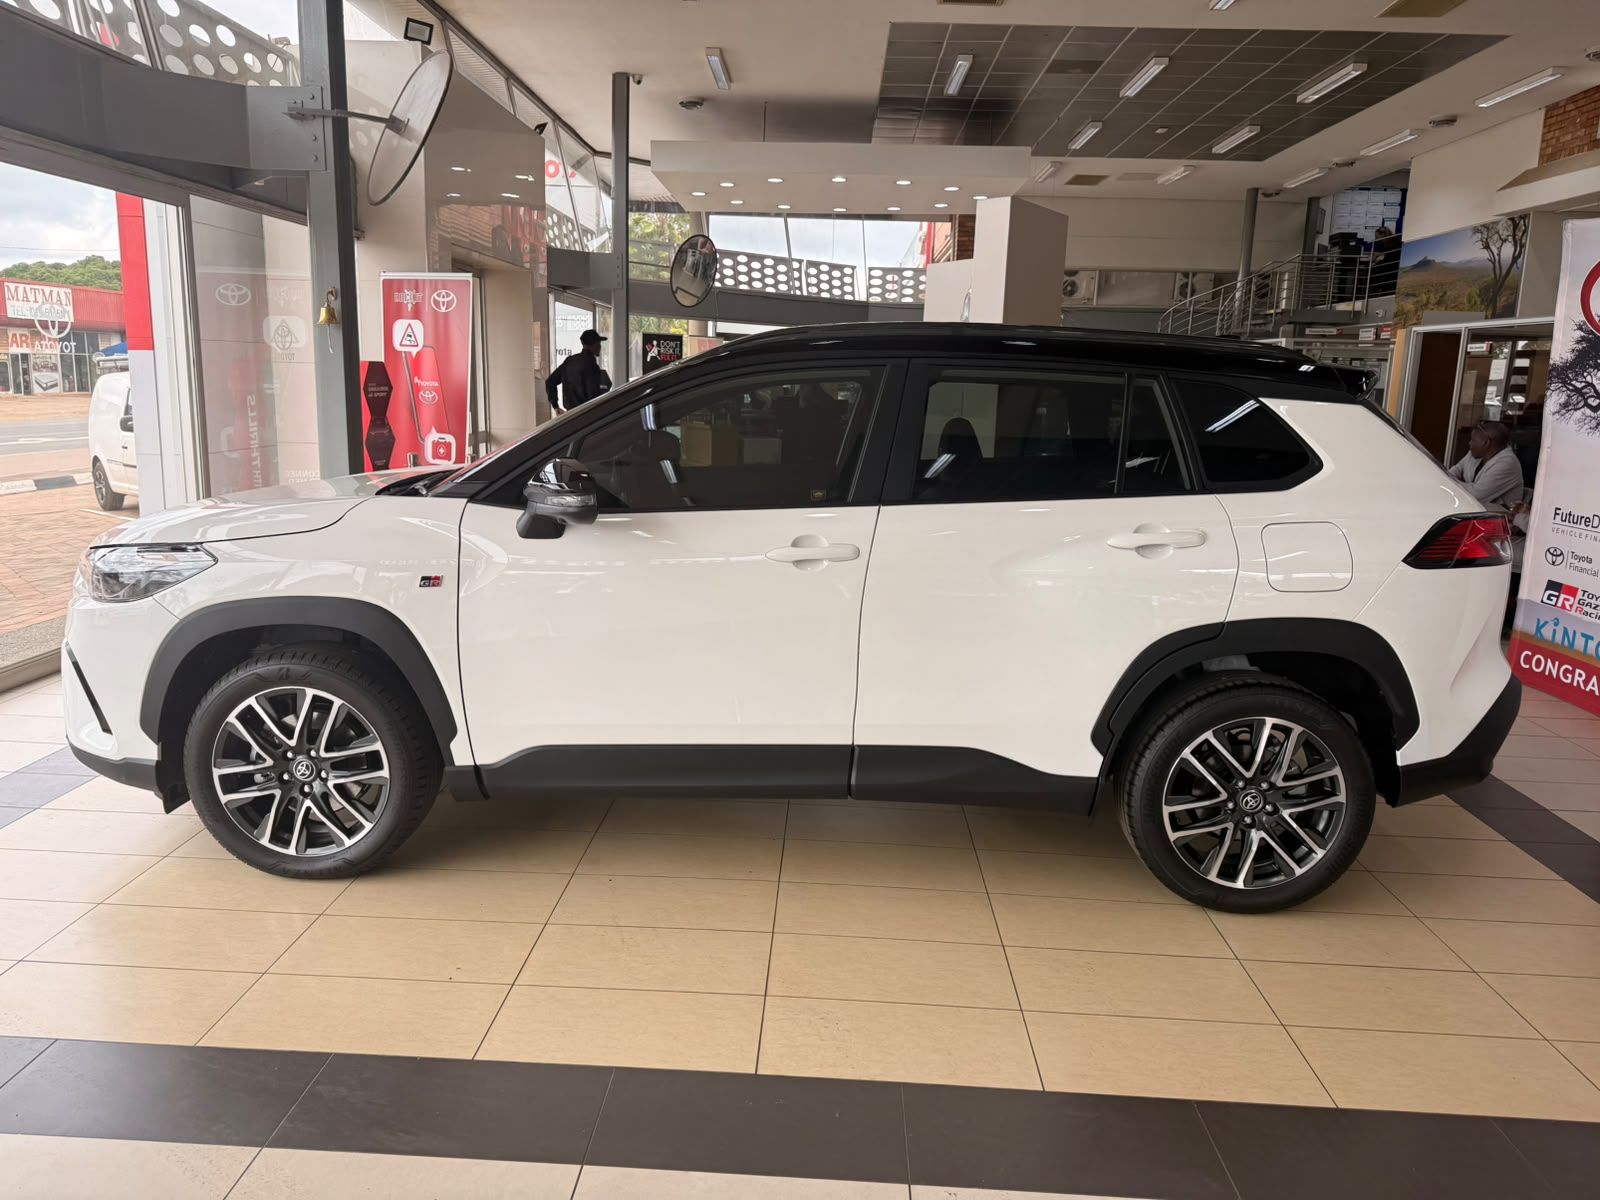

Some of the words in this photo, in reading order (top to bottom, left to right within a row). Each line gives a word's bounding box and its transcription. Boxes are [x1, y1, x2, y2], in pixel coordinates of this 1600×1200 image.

[6, 285, 71, 306] MATMAN
[660, 340, 681, 348] DON'T
[1553, 507, 1600, 529] FutureD
[1551, 526, 1583, 539] VEHICLE
[1584, 533, 1600, 543] FIN
[1570, 551, 1593, 564] Toyota
[1568, 562, 1599, 578] Financial
[419, 577, 442, 587] GR
[1541, 588, 1576, 611] GR
[1580, 589, 1600, 601] TOY
[1519, 650, 1600, 697] CONGRA
